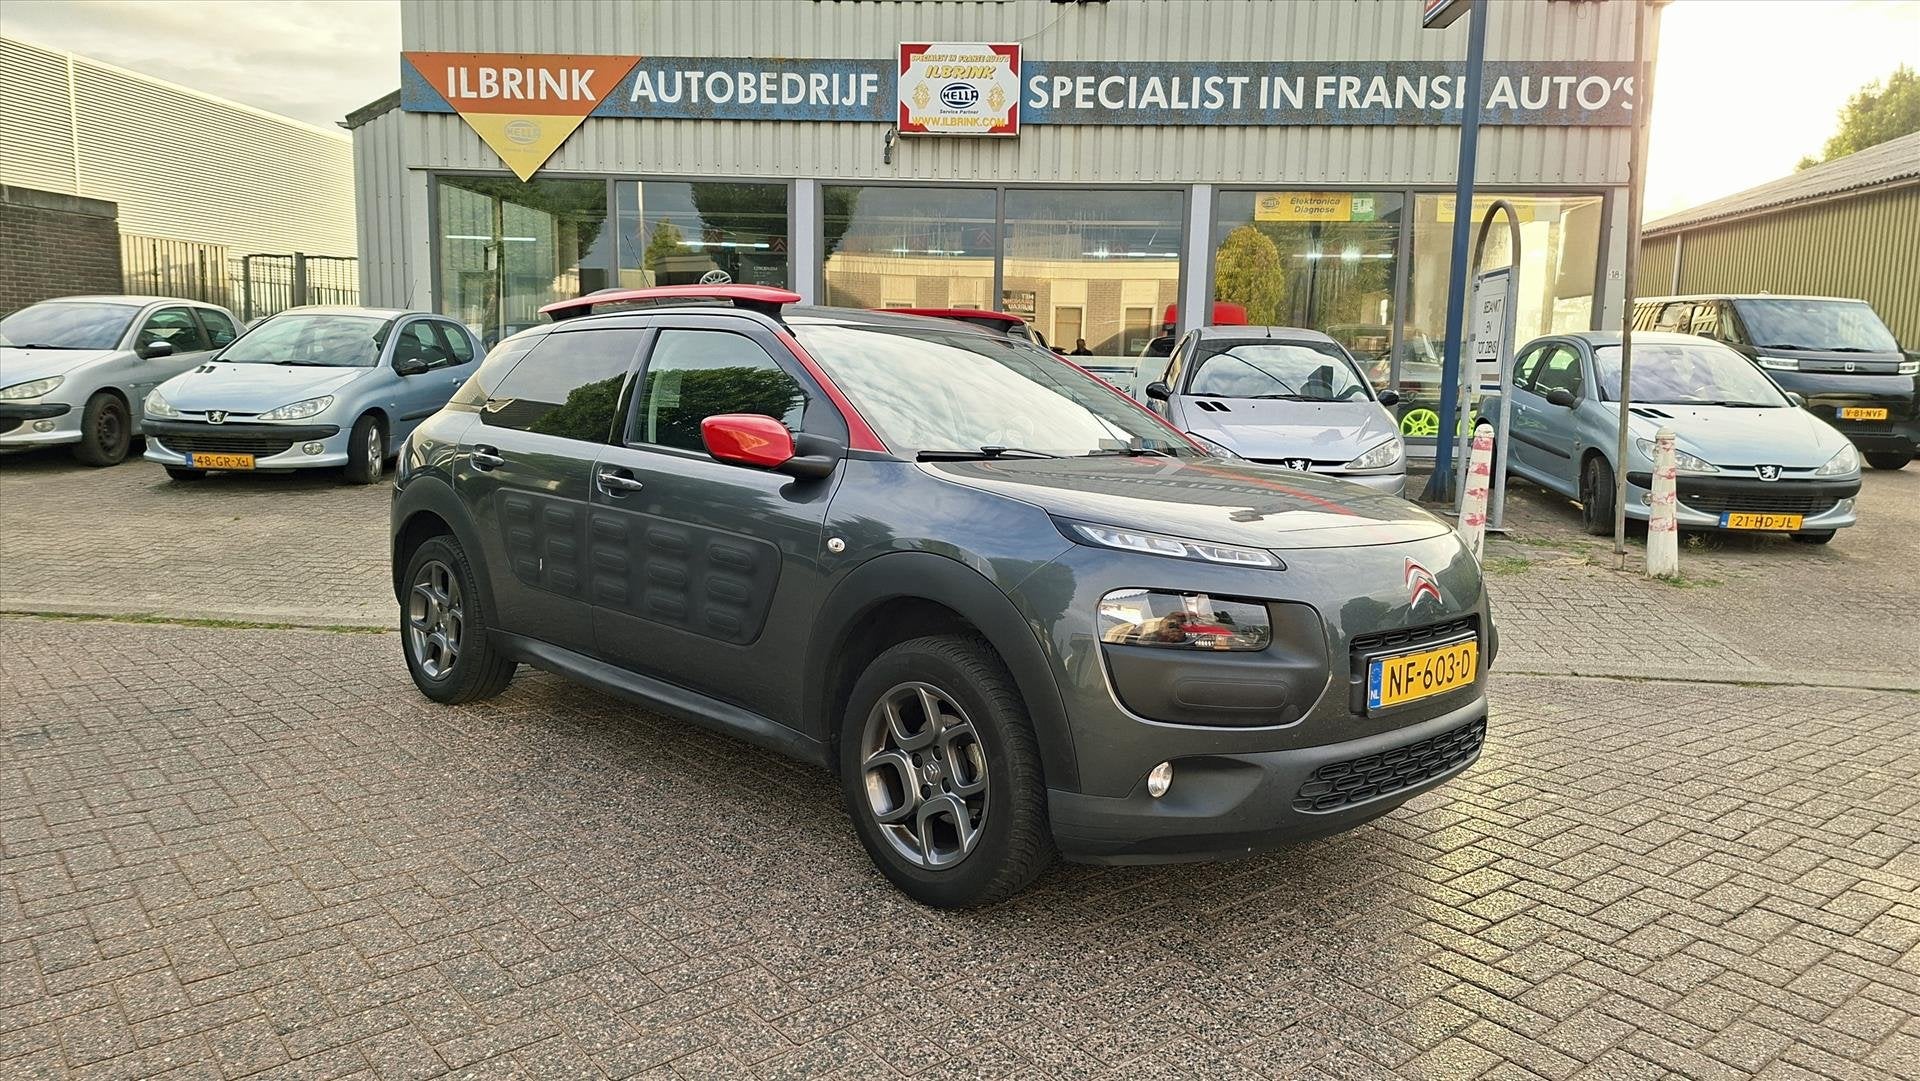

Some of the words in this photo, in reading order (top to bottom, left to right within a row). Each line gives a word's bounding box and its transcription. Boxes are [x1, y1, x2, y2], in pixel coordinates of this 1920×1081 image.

[926, 65, 996, 79] ILBRINK
[447, 66, 597, 101] ILBRINK
[630, 71, 879, 106] AUTOBEDRIJF
[942, 90, 979, 101] HELLA
[1028, 75, 1250, 110] SPECIALIST
[1260, 76, 1305, 109] IN
[912, 116, 1006, 128] WWW.ILBRINK.COM
[1290, 197, 1341, 205] Elektronica
[1294, 206, 1335, 214] Diagnose
[1735, 516, 1793, 528] 21-HD-JL
[1389, 649, 1470, 698] NF-603-D
[1370, 690, 1380, 699] NL
